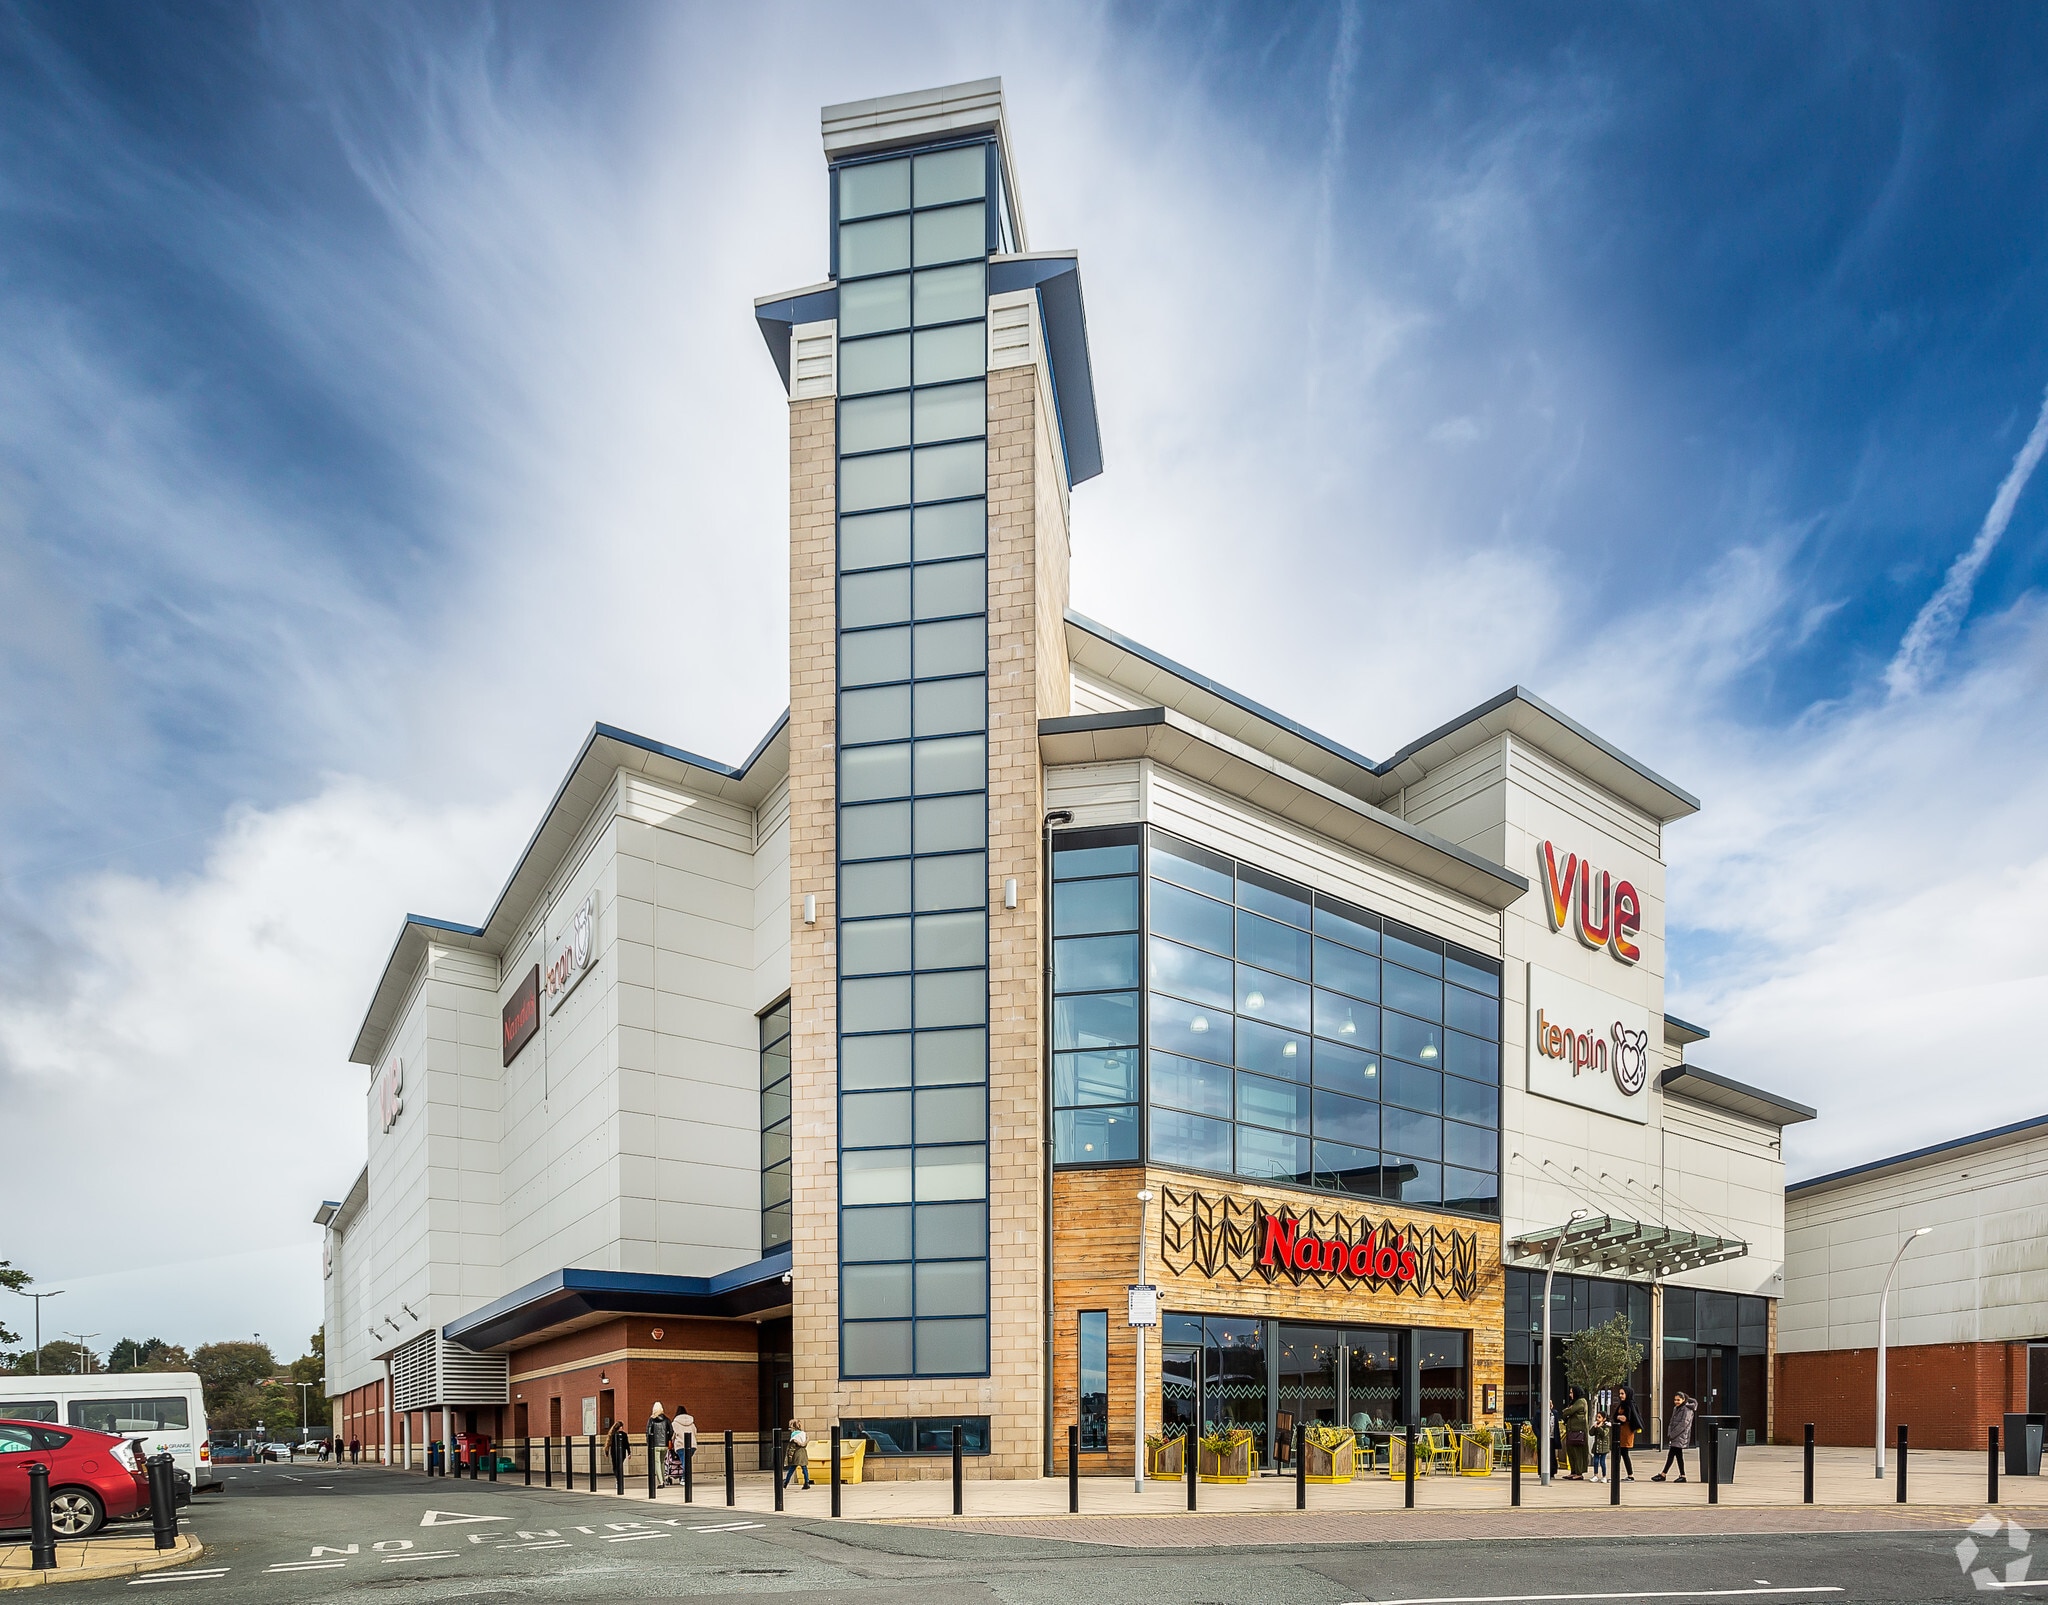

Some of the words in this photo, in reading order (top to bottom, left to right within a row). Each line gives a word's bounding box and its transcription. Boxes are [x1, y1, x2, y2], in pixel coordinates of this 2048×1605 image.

[546, 944, 575, 998] tenpin
[503, 991, 535, 1048] Nando's
[1537, 1008, 1607, 1077] tenpin
[1260, 1215, 1416, 1281] Nando's
[310, 1539, 414, 1557] NO
[466, 1518, 682, 1544] ENTRY
